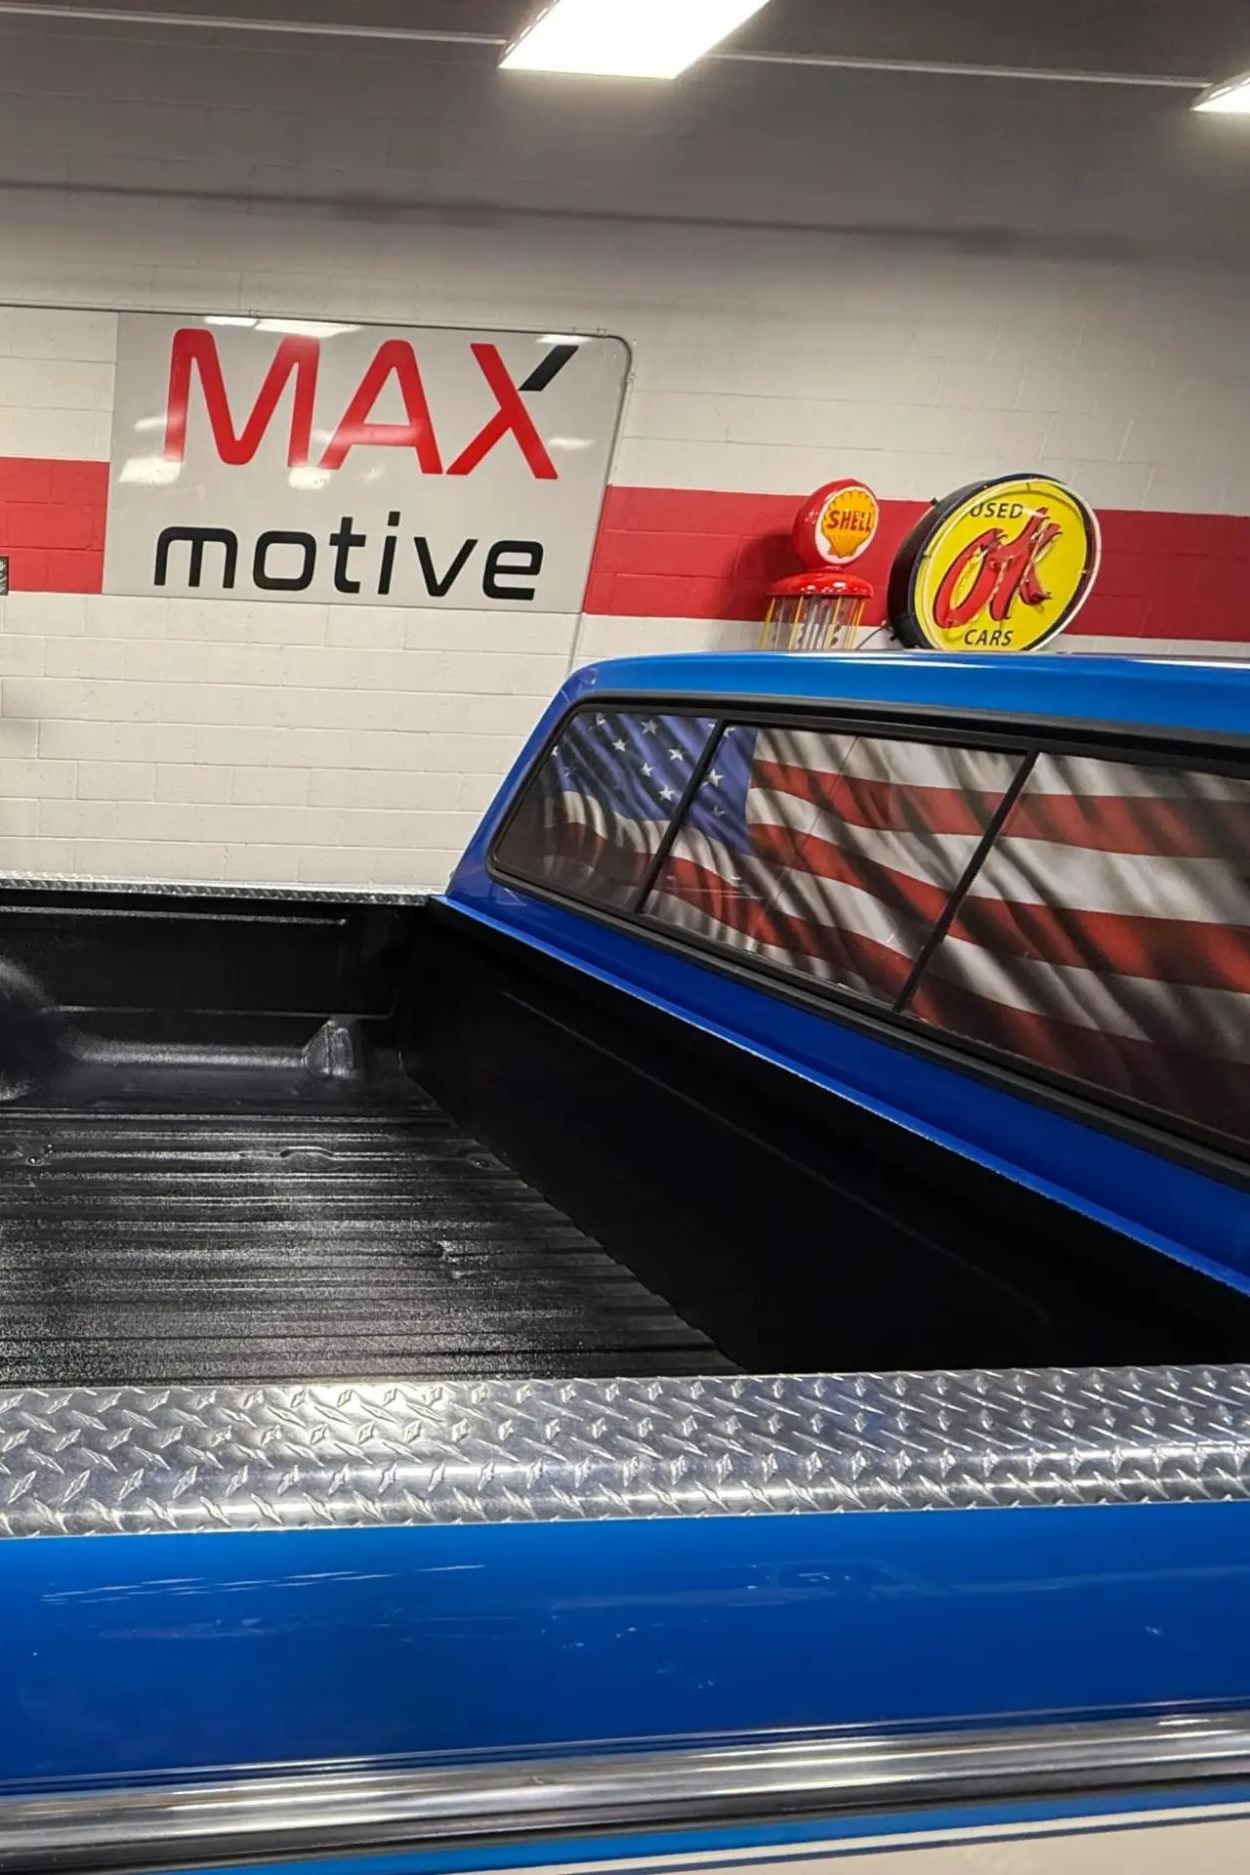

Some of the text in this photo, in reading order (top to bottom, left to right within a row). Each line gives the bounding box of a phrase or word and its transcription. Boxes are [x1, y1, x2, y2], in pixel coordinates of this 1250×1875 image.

[162, 328, 579, 480] MAX
[827, 510, 872, 533] SHELL
[970, 501, 1024, 519] USED
[153, 511, 544, 601] motive
[933, 507, 1062, 629] OK
[964, 629, 1013, 646] CARS
